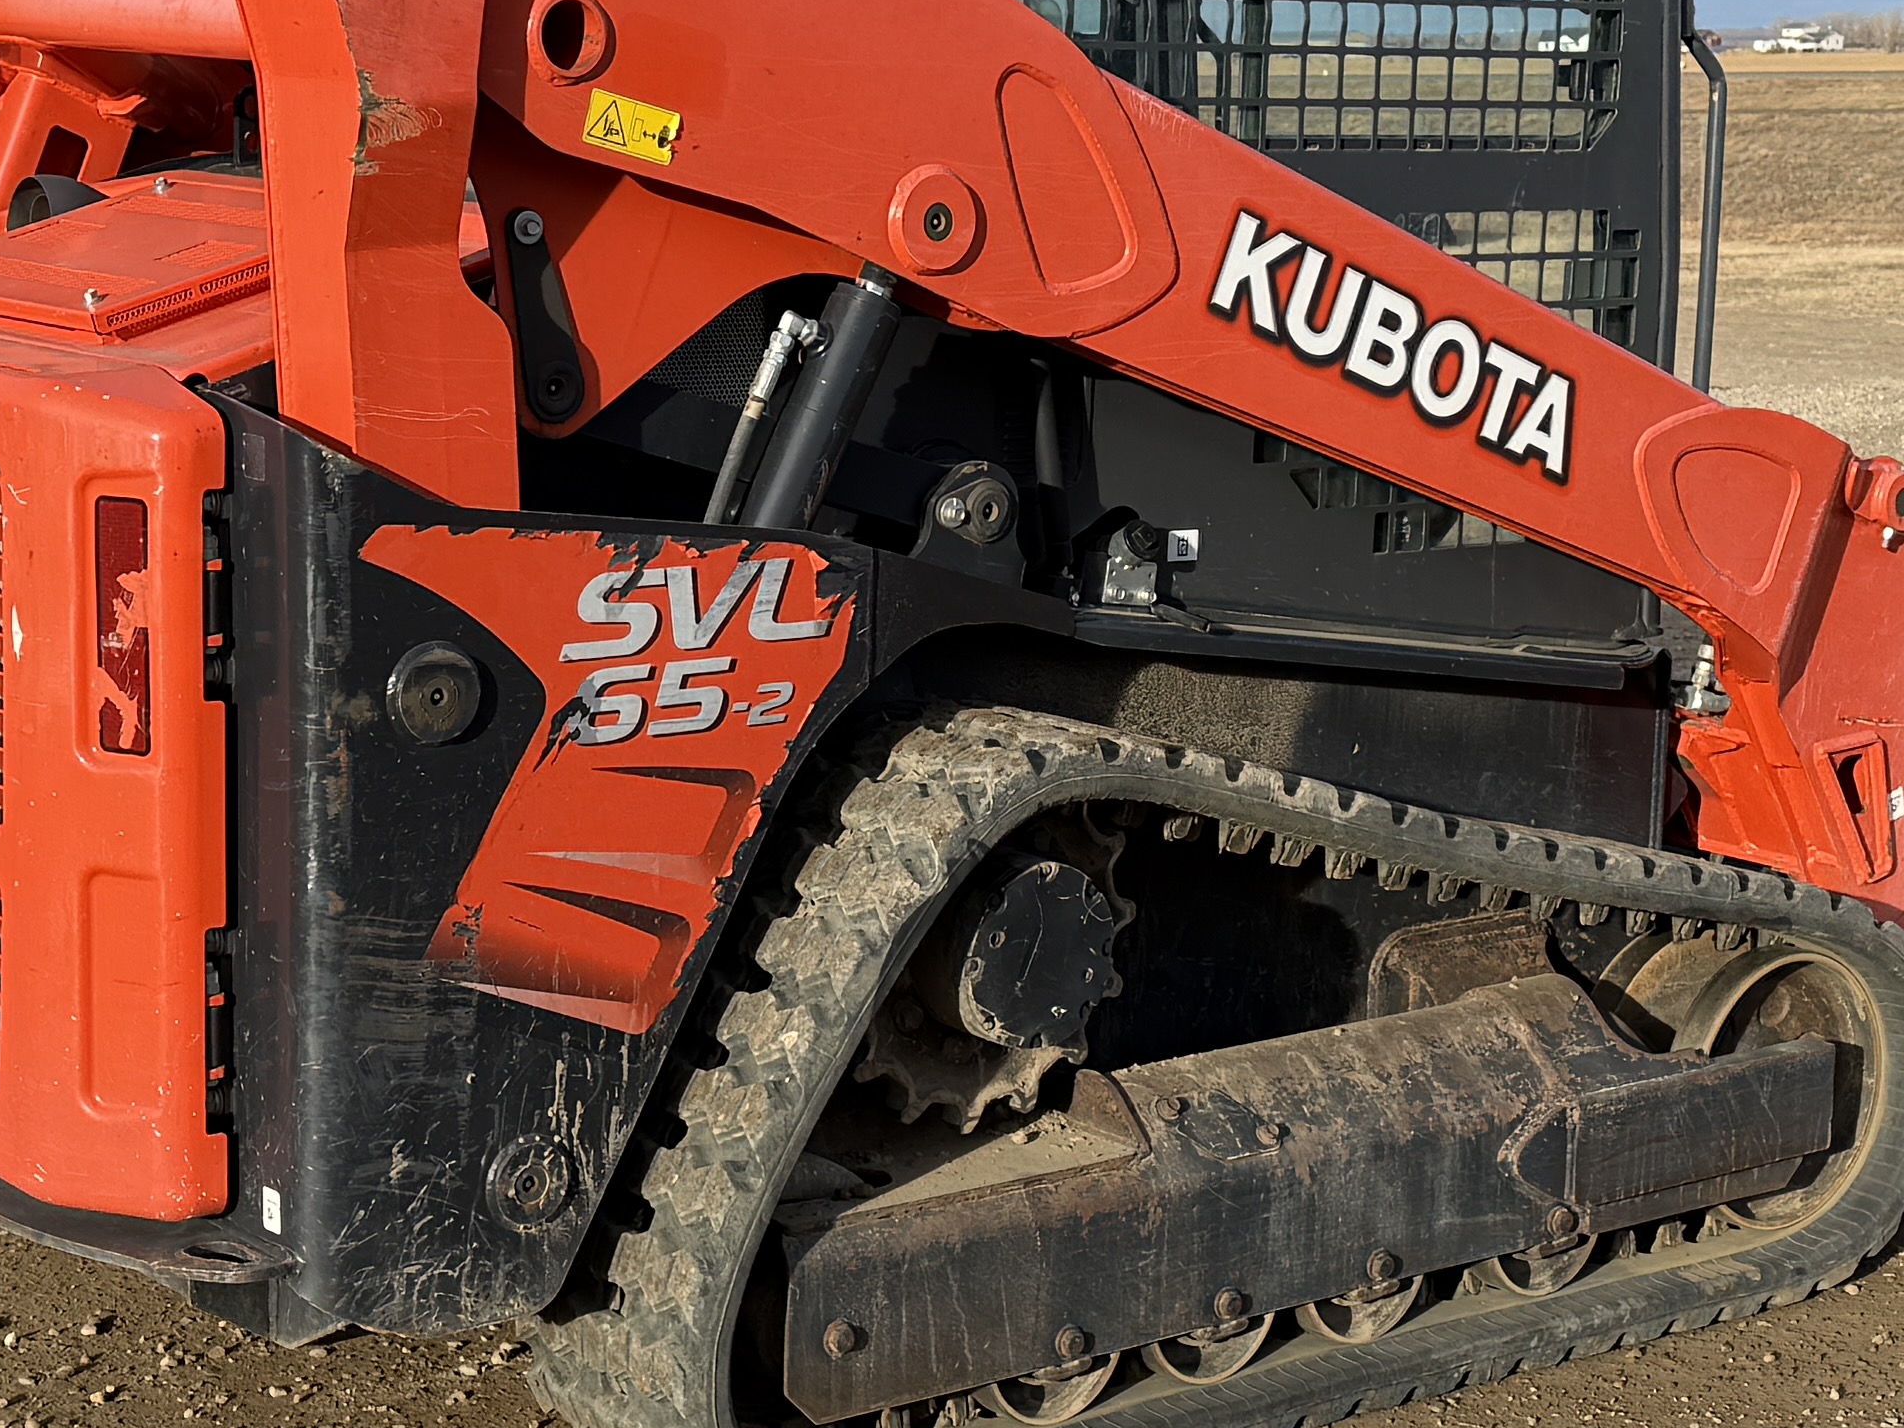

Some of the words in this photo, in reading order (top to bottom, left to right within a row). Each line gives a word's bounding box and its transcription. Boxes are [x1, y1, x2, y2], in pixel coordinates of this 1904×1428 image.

[1209, 210, 1573, 478] KUBOTA
[558, 557, 834, 662] SVL
[571, 656, 796, 746] 65-2
